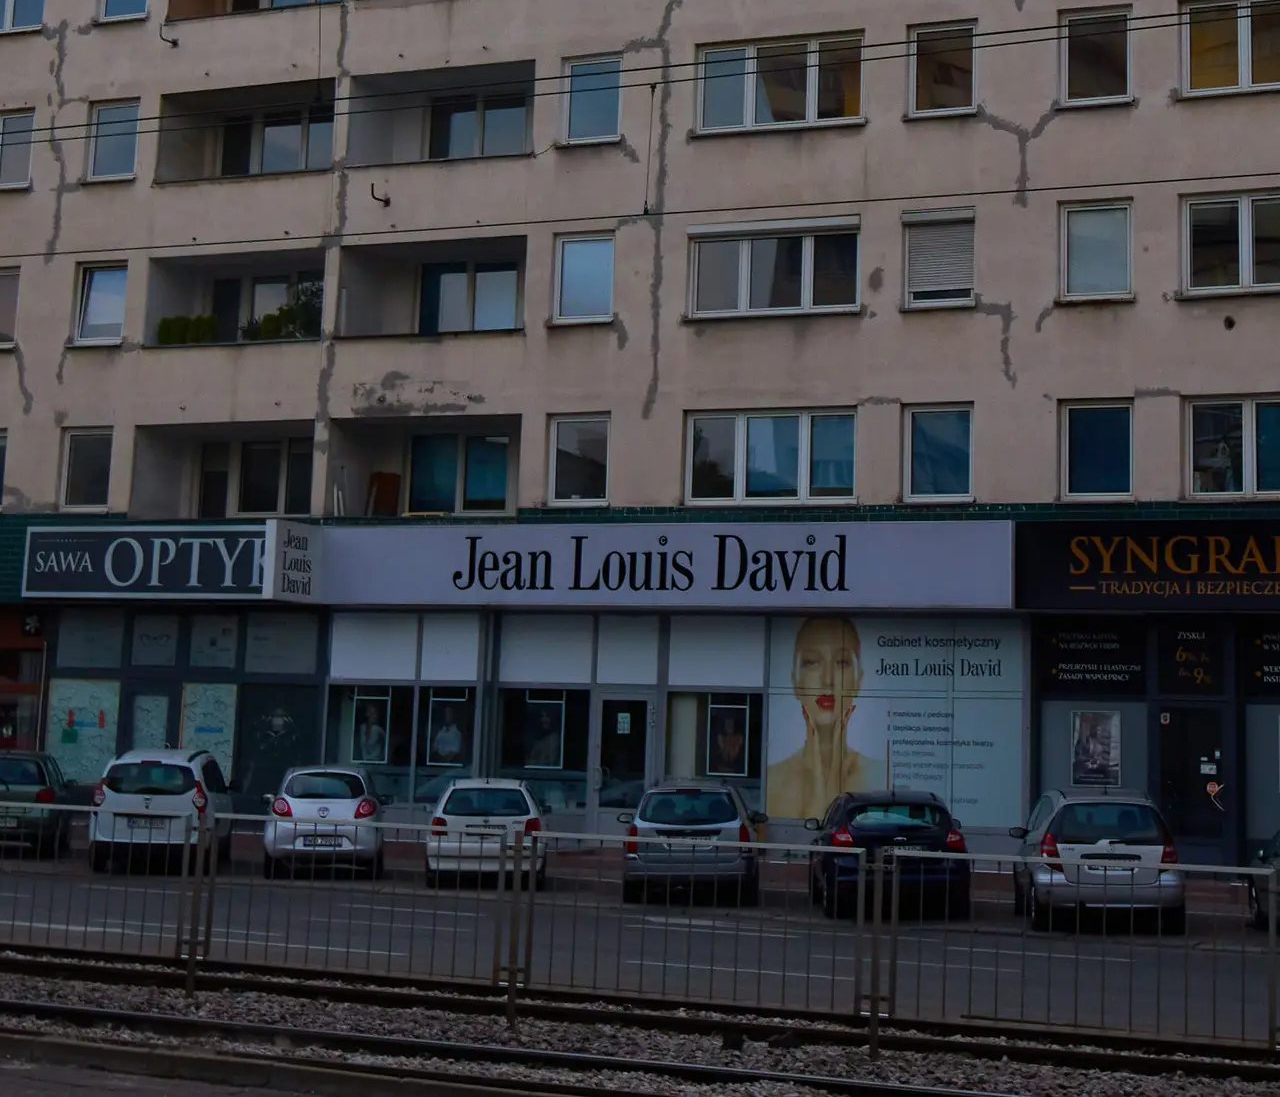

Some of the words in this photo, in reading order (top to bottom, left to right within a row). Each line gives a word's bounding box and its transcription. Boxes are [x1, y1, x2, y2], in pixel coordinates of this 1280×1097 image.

[283, 528, 308, 552] Jean
[34, 550, 93, 573] SAWA
[282, 552, 312, 573] Louis
[452, 536, 554, 591] Jean
[568, 535, 694, 591] Louis
[711, 534, 849, 591] David
[281, 573, 311, 596] David
[1099, 580, 1181, 598] TRADYCJA
[1185, 581, 1191, 595] I
[877, 636, 921, 648] Gabinet
[925, 636, 1001, 650] kosmetyczny
[876, 658, 909, 676] Jean
[915, 658, 954, 676] Louis
[960, 659, 1002, 677] David
[936, 739, 970, 748] kosmetyka
